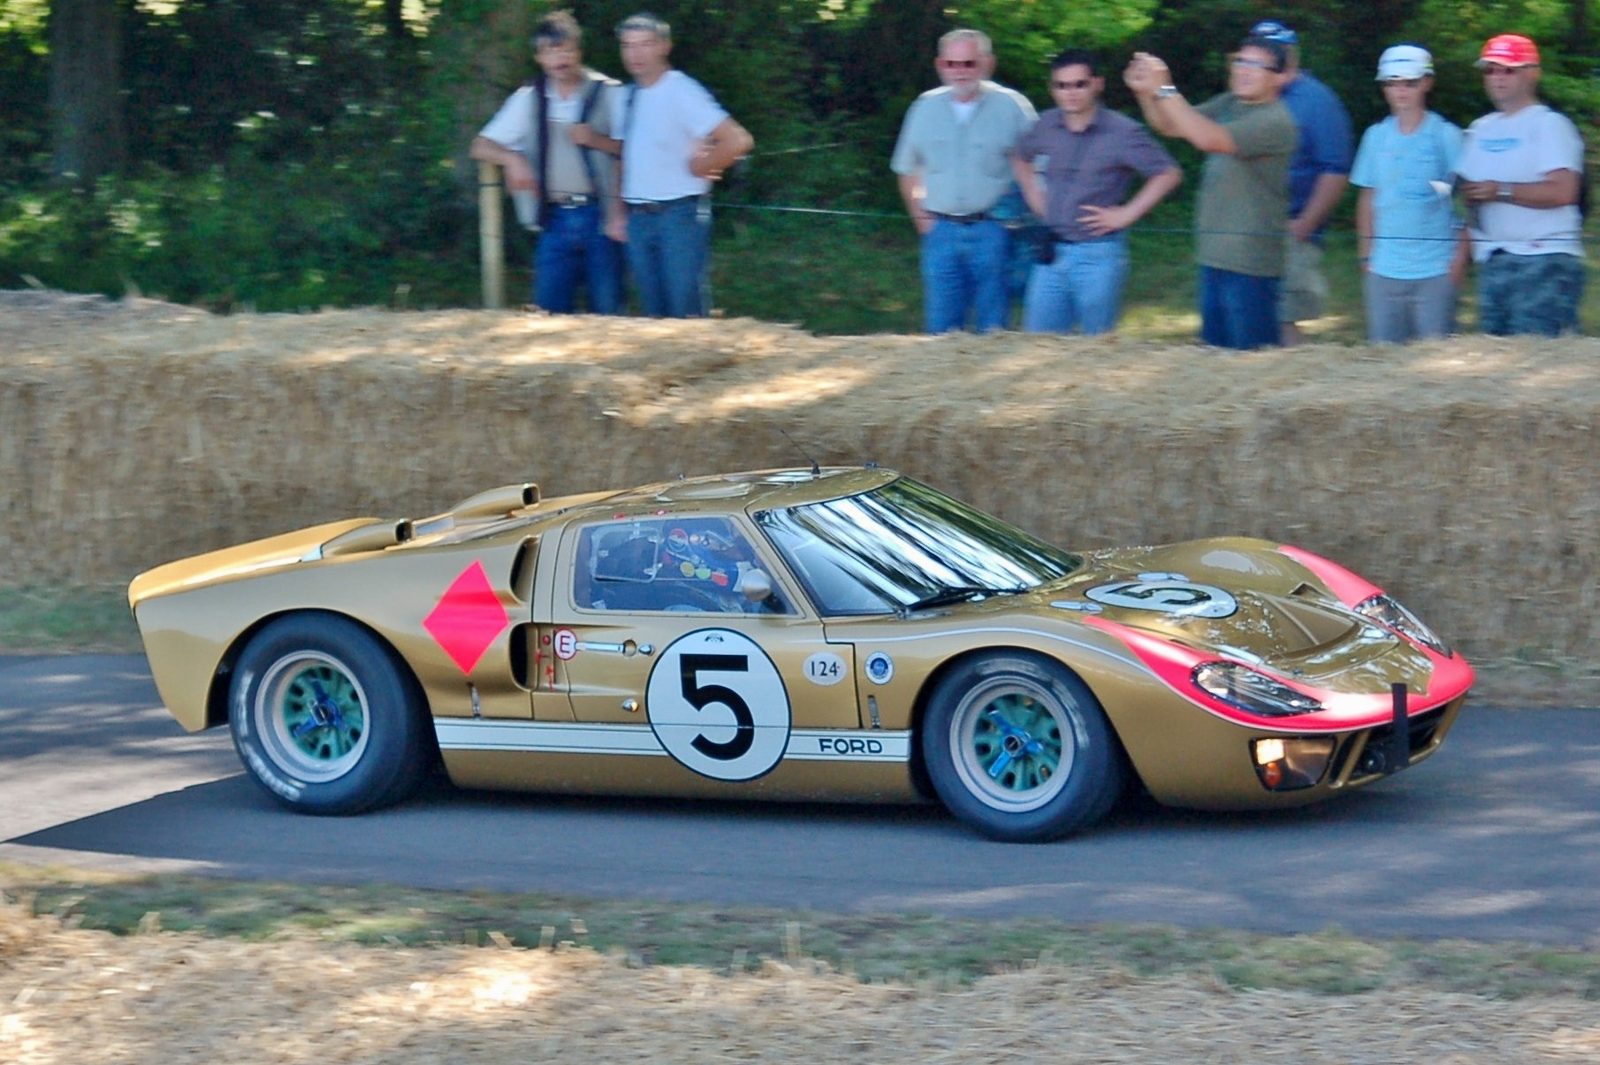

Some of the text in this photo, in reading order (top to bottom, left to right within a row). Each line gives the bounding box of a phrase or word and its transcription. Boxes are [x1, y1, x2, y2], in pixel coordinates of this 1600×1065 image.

[1105, 583, 1212, 606] 5
[559, 635, 571, 654] E
[811, 660, 838, 677] 124
[679, 653, 755, 761] 5
[818, 738, 883, 754] FORD
